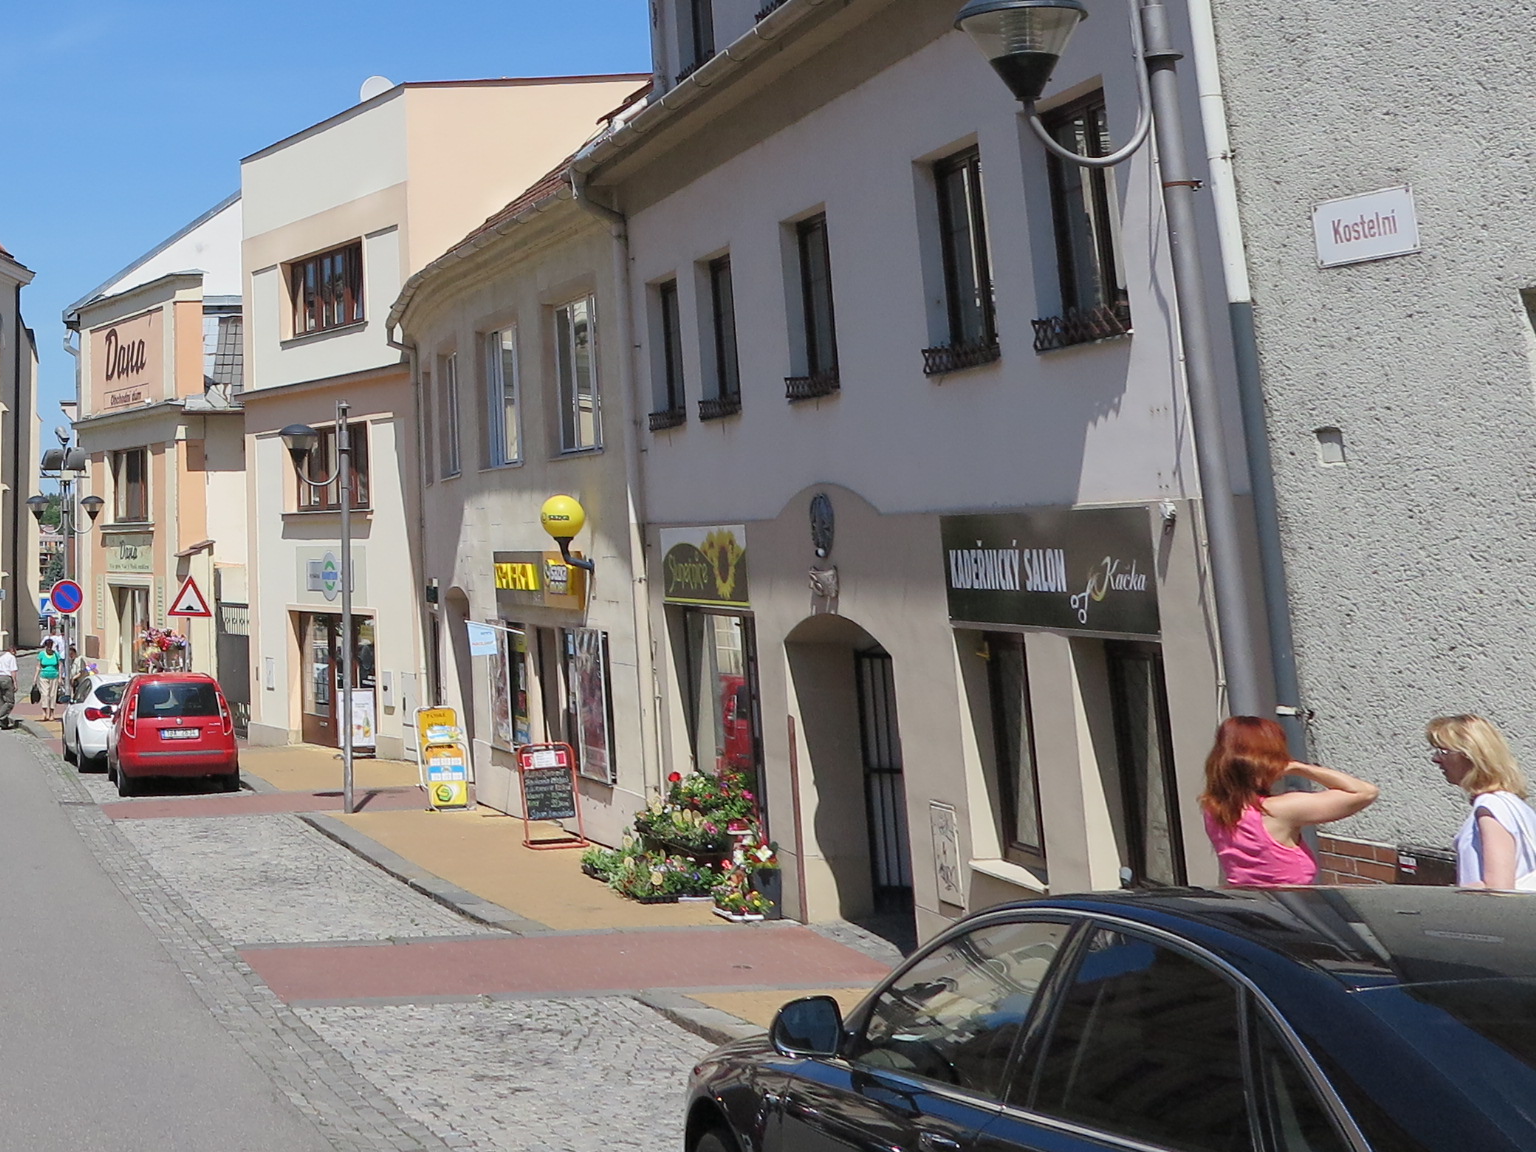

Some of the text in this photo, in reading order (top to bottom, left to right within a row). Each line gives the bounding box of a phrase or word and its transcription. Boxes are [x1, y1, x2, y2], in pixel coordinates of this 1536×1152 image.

[1331, 209, 1398, 245] Kostelní
[105, 327, 147, 382] Dana
[949, 540, 1068, 592] KADEŘNICKÝ SALON
[1098, 556, 1148, 591] Kačka
